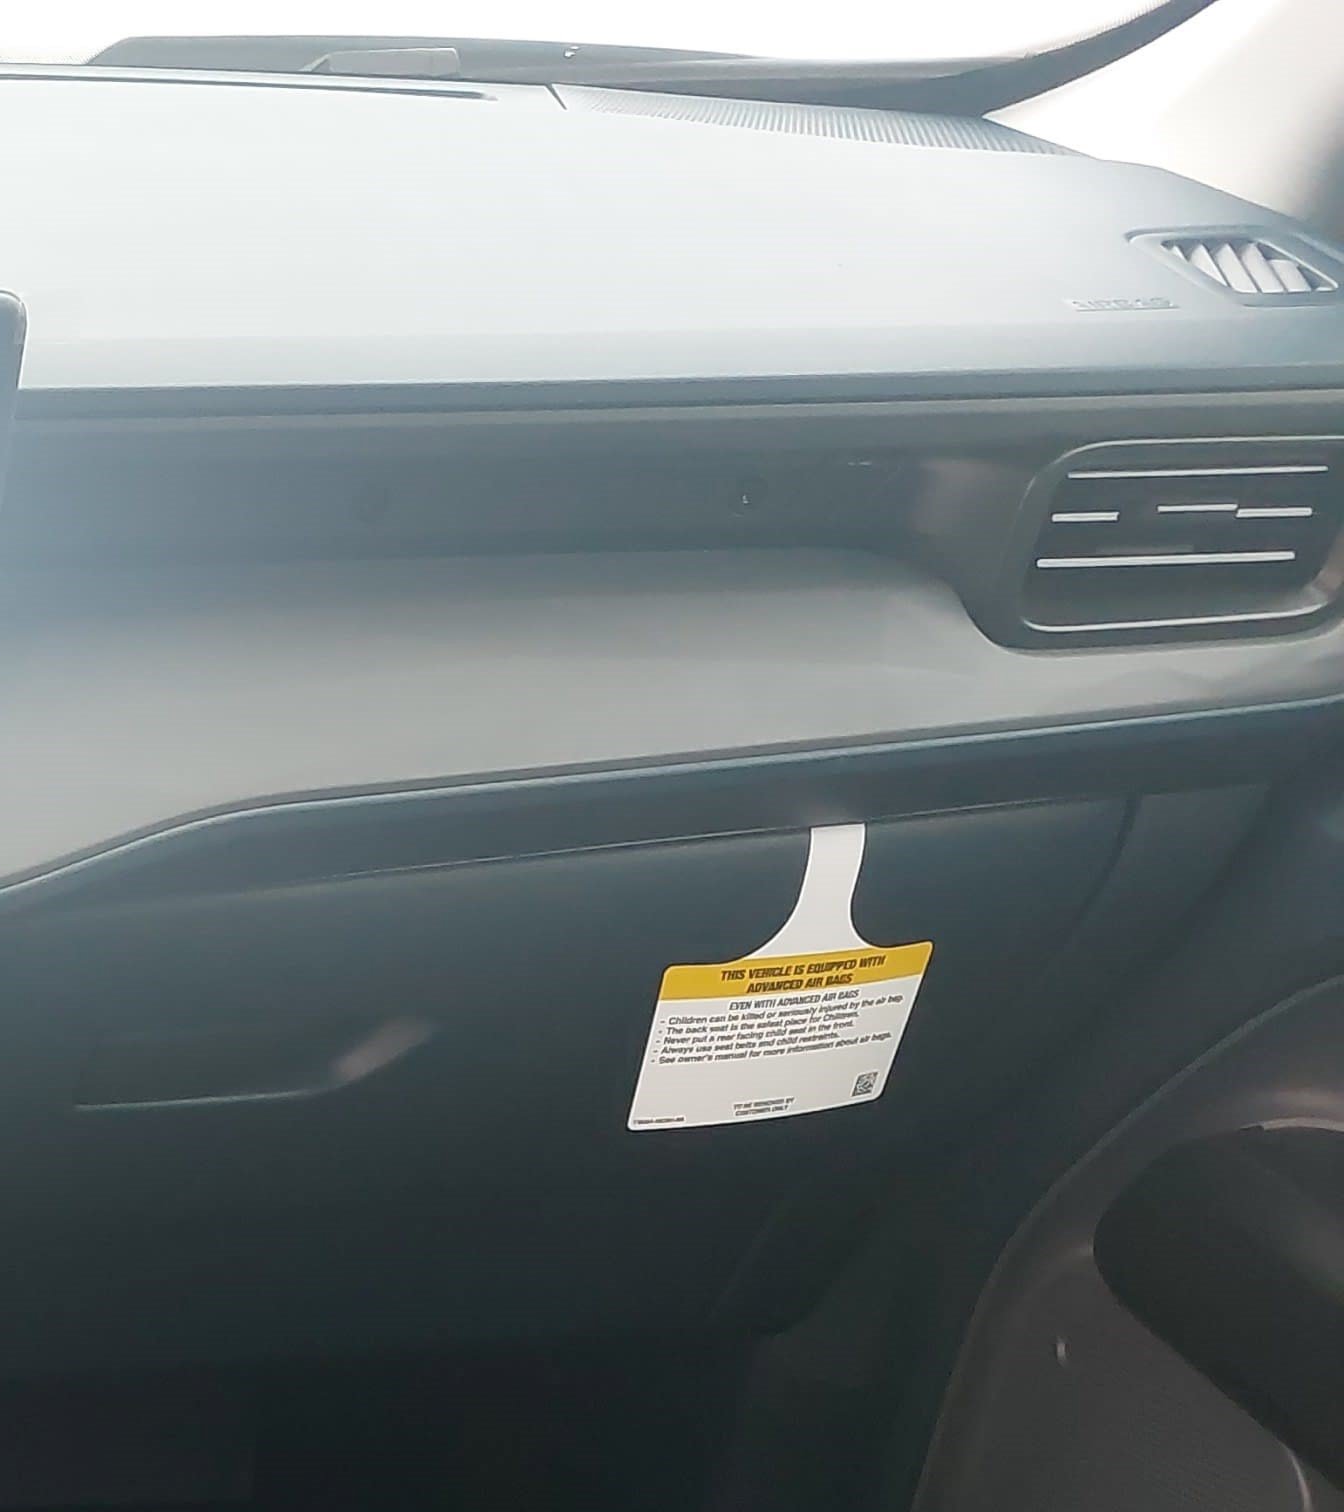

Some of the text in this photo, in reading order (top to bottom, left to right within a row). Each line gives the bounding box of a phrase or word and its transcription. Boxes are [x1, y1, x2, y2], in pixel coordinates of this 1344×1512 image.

[721, 955, 886, 981] THIS VEHICLE IS EQUIPPED WITH
[746, 974, 853, 994] ADVANCED AIR BAGS
[729, 1001, 752, 1011] EVEN
[754, 999, 777, 1009] WITH
[777, 995, 821, 1007] ADVANCED
[822, 993, 837, 1001] AIR
[668, 1016, 707, 1025] Children
[709, 1015, 726, 1023] can
[741, 1011, 765, 1020] killed
[666, 1027, 684, 1035] The
[685, 1025, 707, 1034] back
[663, 1036, 692, 1045] Never
[692, 1035, 708, 1045] put
[660, 1046, 694, 1055] Always
[658, 1056, 675, 1064] See
[714, 1051, 747, 1061] manual
